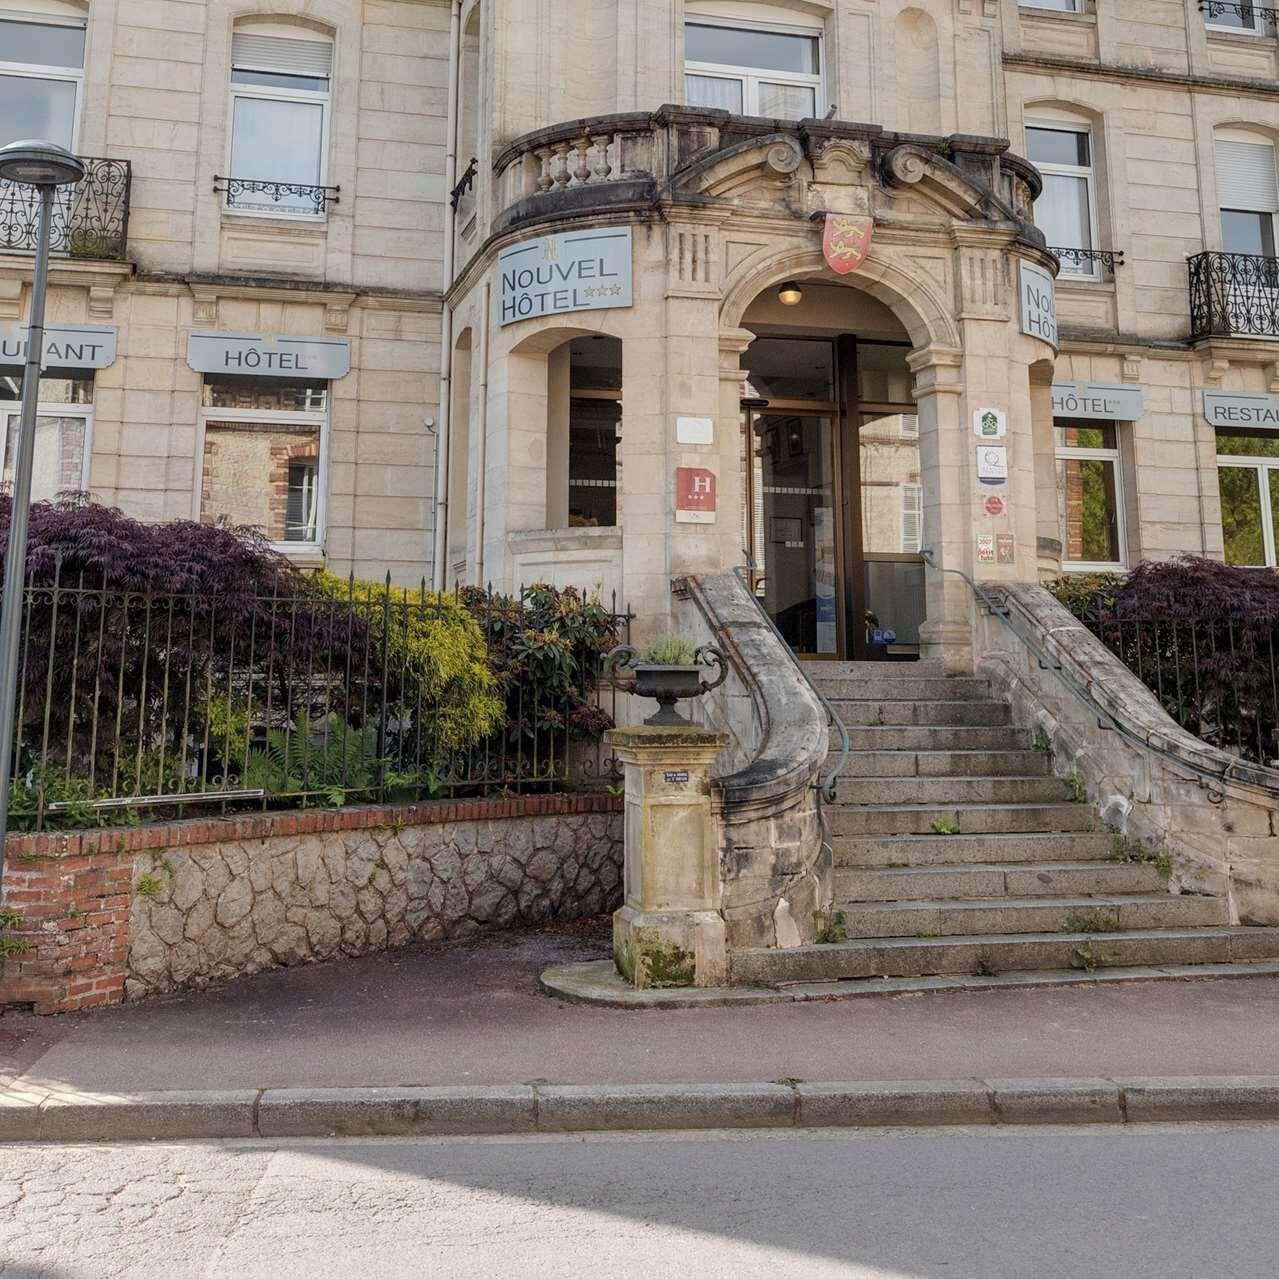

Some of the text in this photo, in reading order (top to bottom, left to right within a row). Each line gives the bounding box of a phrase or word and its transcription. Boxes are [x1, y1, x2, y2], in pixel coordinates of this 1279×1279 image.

[502, 258, 618, 295] NOUVEL
[502, 288, 591, 321] HÔTEL
[224, 348, 309, 370] HÔTEL
[1051, 393, 1115, 413] HÔTEL
[694, 476, 711, 493] H
